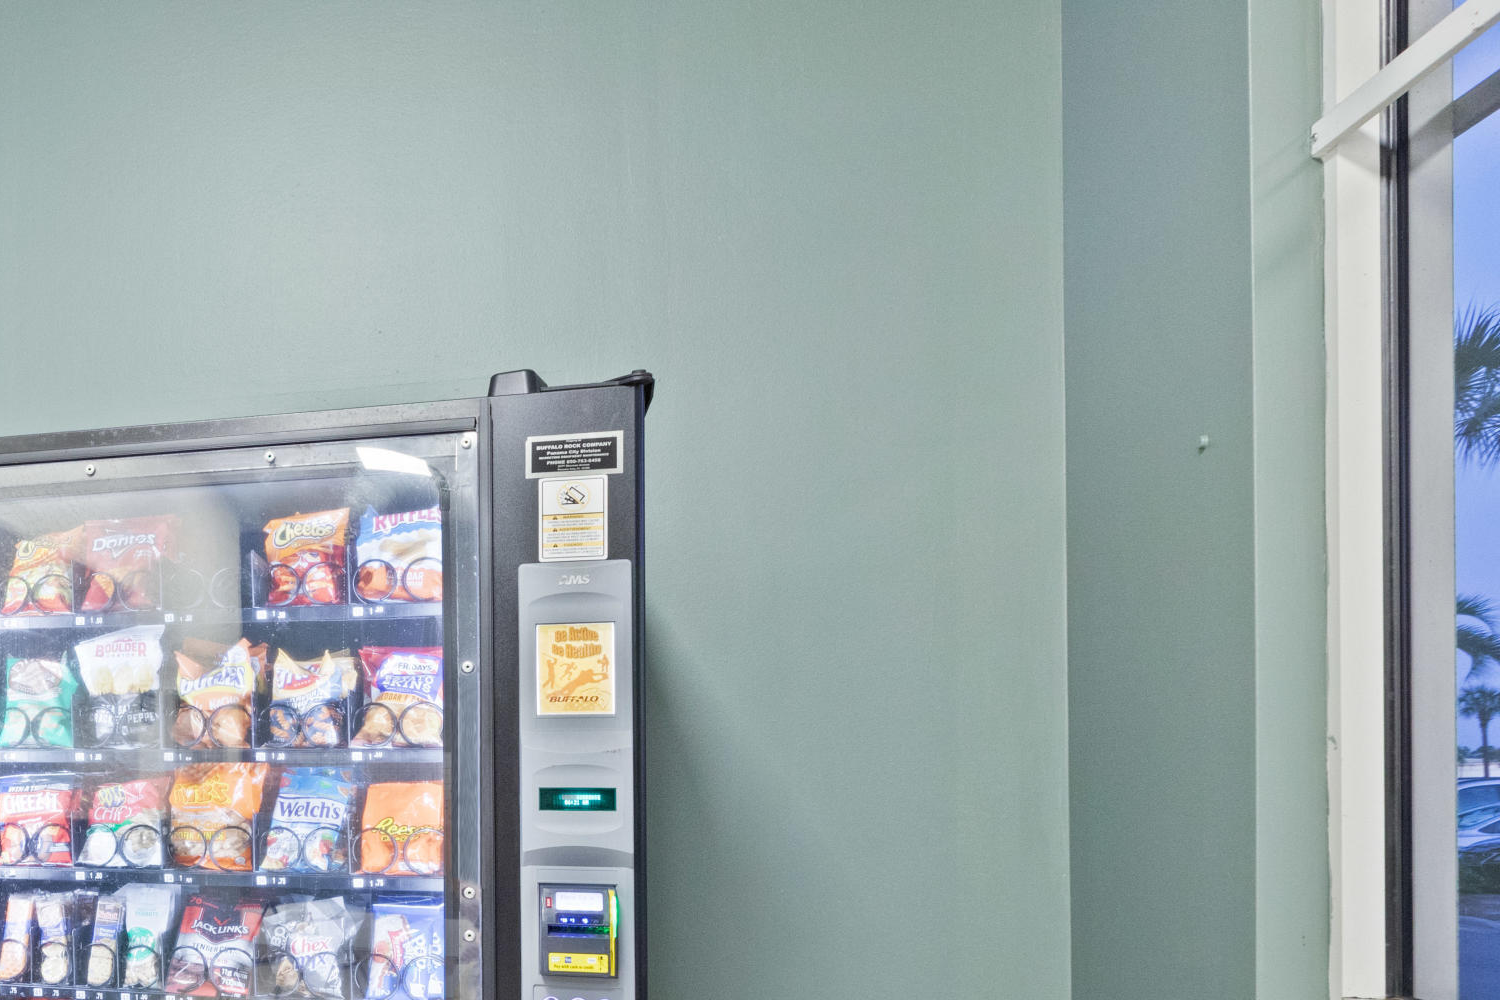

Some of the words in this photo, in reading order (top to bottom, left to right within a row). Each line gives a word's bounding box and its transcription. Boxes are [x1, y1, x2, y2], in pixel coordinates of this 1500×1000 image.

[92, 534, 156, 552] Doritos
[274, 522, 335, 546] Cheetos
[569, 627, 599, 642] Active
[95, 640, 147, 658] BOULDER
[279, 800, 342, 820] Welch's
[190, 919, 216, 935] JACK
[290, 935, 333, 956] Chex
